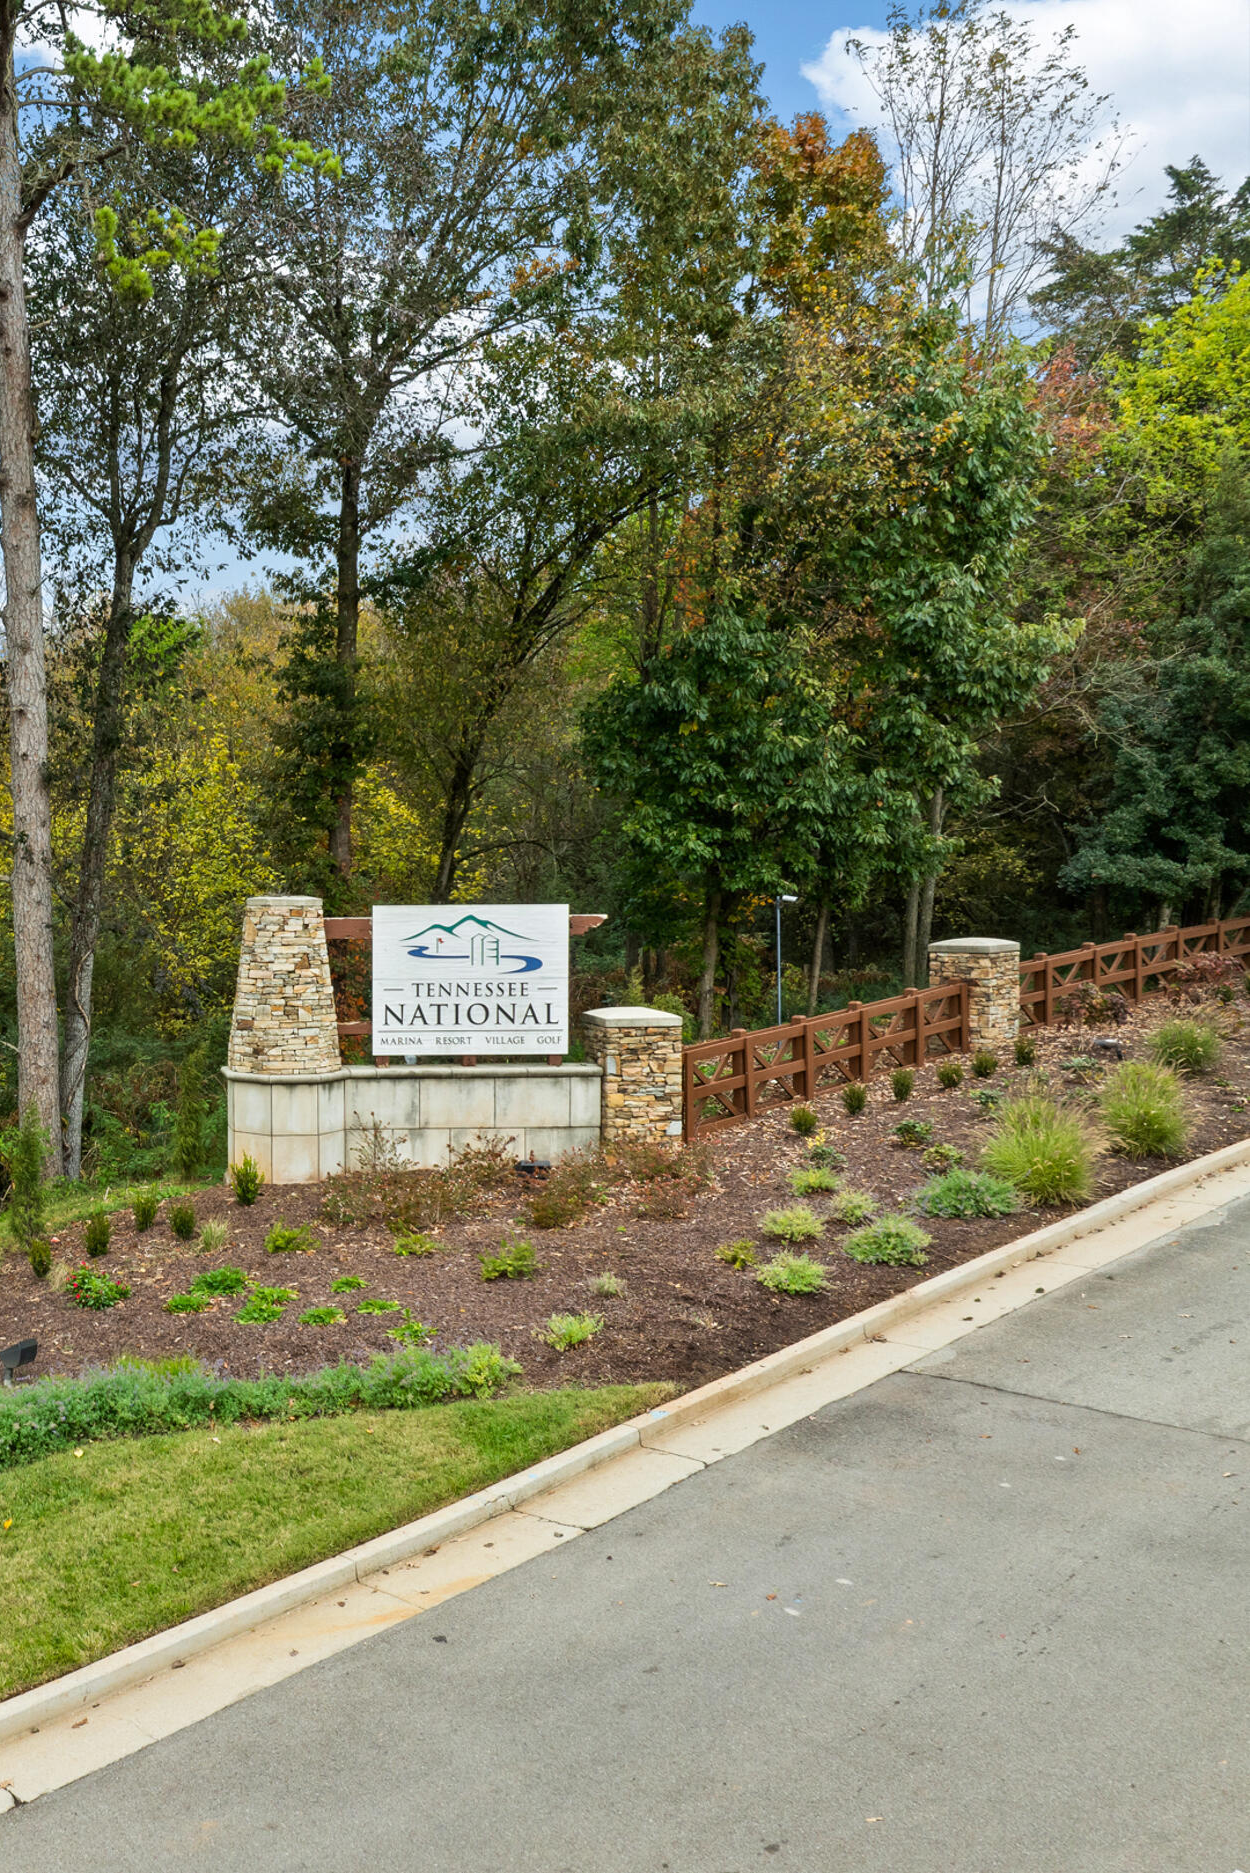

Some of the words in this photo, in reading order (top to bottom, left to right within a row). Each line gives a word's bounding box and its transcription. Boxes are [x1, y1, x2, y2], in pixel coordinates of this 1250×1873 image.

[411, 982, 529, 998] TENNESSEE
[383, 1002, 559, 1026] NATIONAL
[380, 1036, 423, 1046] MARINA
[435, 1036, 472, 1046] RESORT
[485, 1035, 525, 1046] VILLAGE
[537, 1035, 562, 1045] GOLF
